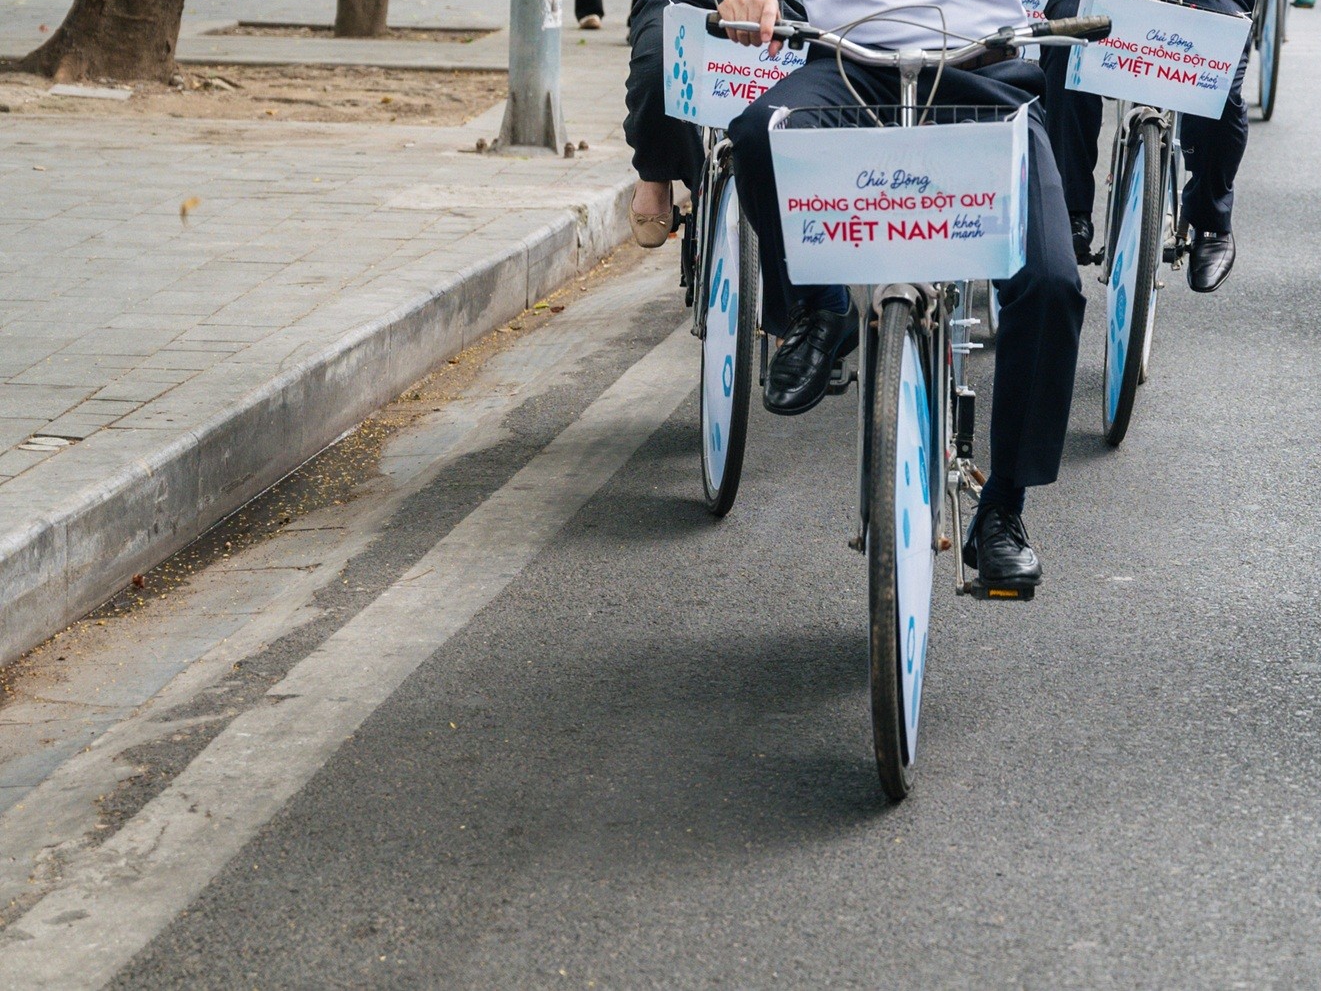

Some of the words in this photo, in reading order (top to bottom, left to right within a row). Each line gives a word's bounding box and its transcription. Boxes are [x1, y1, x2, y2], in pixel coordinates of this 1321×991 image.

[1146, 29, 1166, 43] Chủ
[1167, 33, 1194, 52] Động
[782, 51, 807, 67] Độn
[1098, 37, 1138, 53] PHÒNG
[1140, 45, 1181, 62] CHỐNG
[1183, 54, 1206, 68] ĐỘT
[1208, 60, 1232, 75] QUỴ
[1103, 52, 1113, 62] Vì
[708, 61, 750, 77] PHÒNG
[754, 66, 790, 80] CHỐN
[1117, 55, 1154, 78] VIỆT
[1157, 66, 1198, 86] NAM
[714, 78, 725, 90] Vì
[729, 80, 769, 104] VIỆT
[1196, 80, 1218, 90] mạnh
[856, 170, 888, 189] Chủ
[890, 169, 931, 194] Động
[788, 194, 849, 212] PHÒNG
[853, 190, 916, 210] CHỐNG
[921, 192, 956, 212] ĐỘT
[960, 192, 996, 210] QUỴ
[803, 219, 816, 235] Vì
[822, 215, 879, 248] VIỆT
[887, 220, 949, 241] NAM
[951, 227, 985, 240] mạnh
